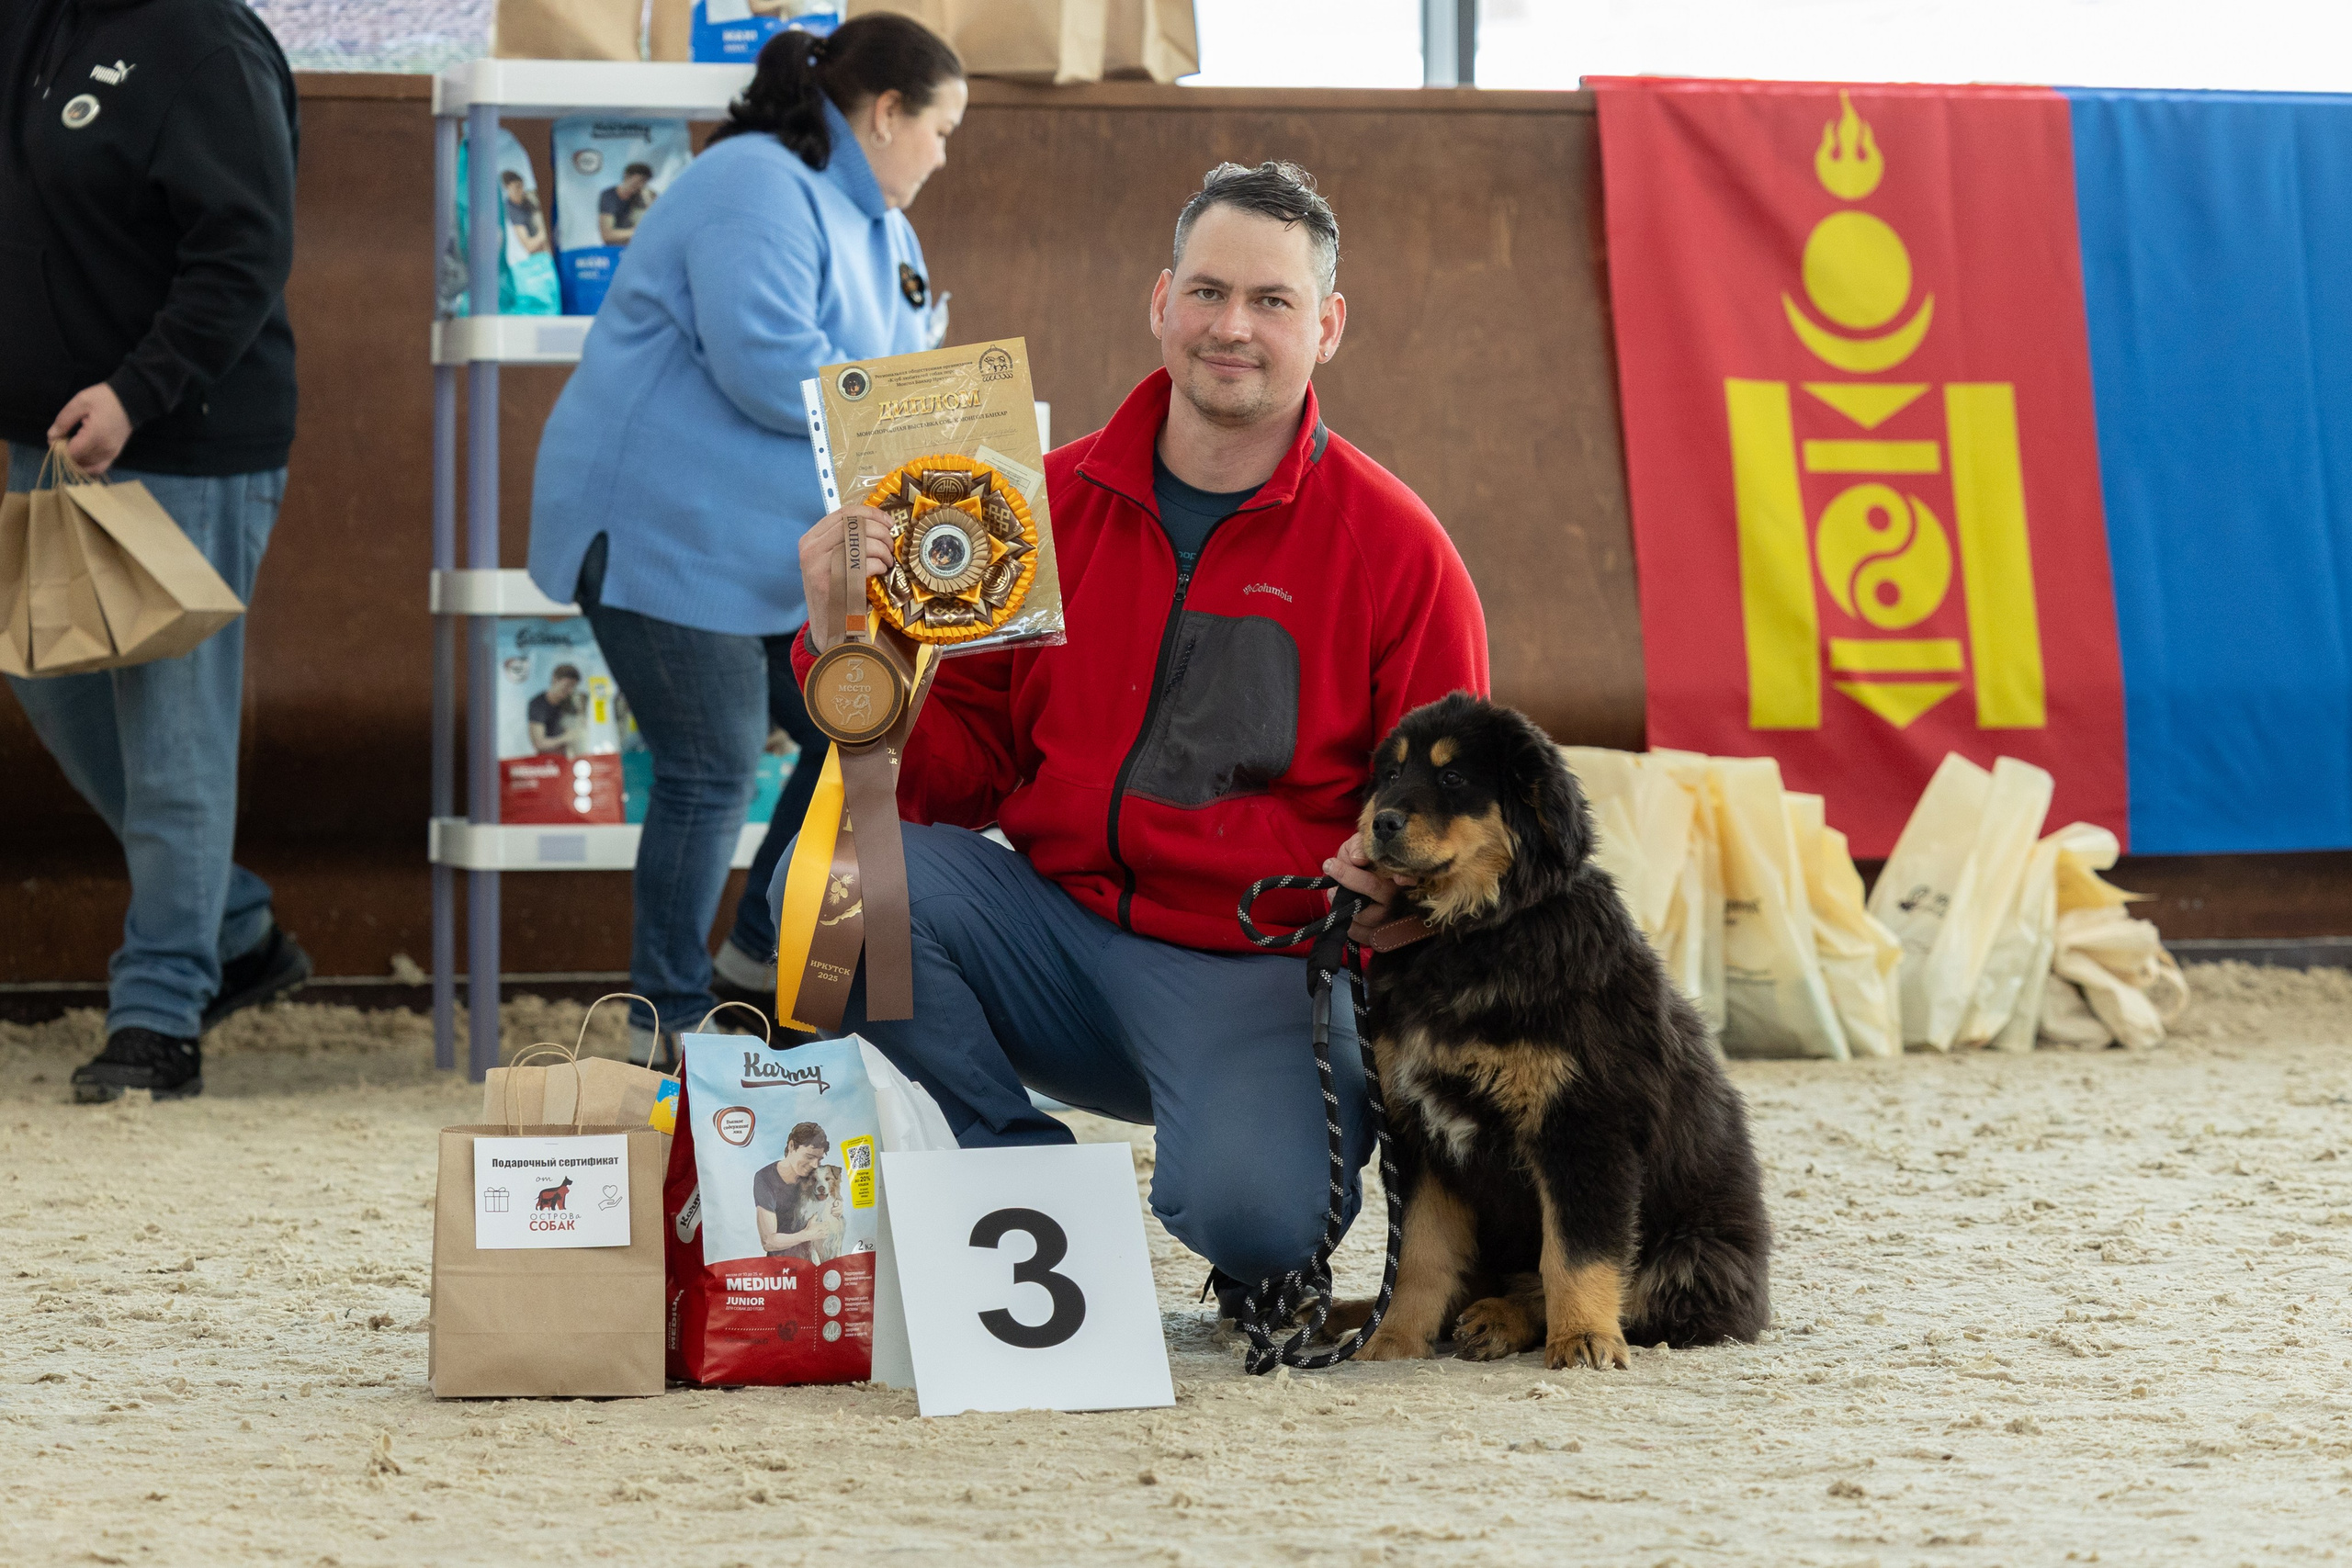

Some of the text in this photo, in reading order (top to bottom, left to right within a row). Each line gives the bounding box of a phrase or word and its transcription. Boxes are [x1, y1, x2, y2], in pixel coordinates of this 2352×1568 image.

[89, 64, 121, 86] PUMA
[876, 388, 981, 423] ДИПЛОМ
[907, 421, 939, 431] ВЫСТАВКА
[939, 417, 959, 426] СОБК
[985, 410, 1008, 419] БАНХАР
[847, 515, 861, 570] МОНГОЛ
[1252, 582, 1293, 603] Columbia
[844, 659, 865, 683] 3
[838, 684, 872, 693] место
[809, 959, 851, 976] ИРКУТСК
[817, 971, 839, 982] 2025
[742, 1052, 824, 1094] Karmy
[492, 1156, 619, 1168] Подарочный сертификат
[529, 1220, 575, 1232] СОБАК
[857, 1239, 864, 1250] 2
[726, 1276, 797, 1292] MEDIUM
[968, 1207, 1086, 1348] 3
[726, 1296, 765, 1305] JUNIOR
[671, 1289, 684, 1350] MEDIUM
